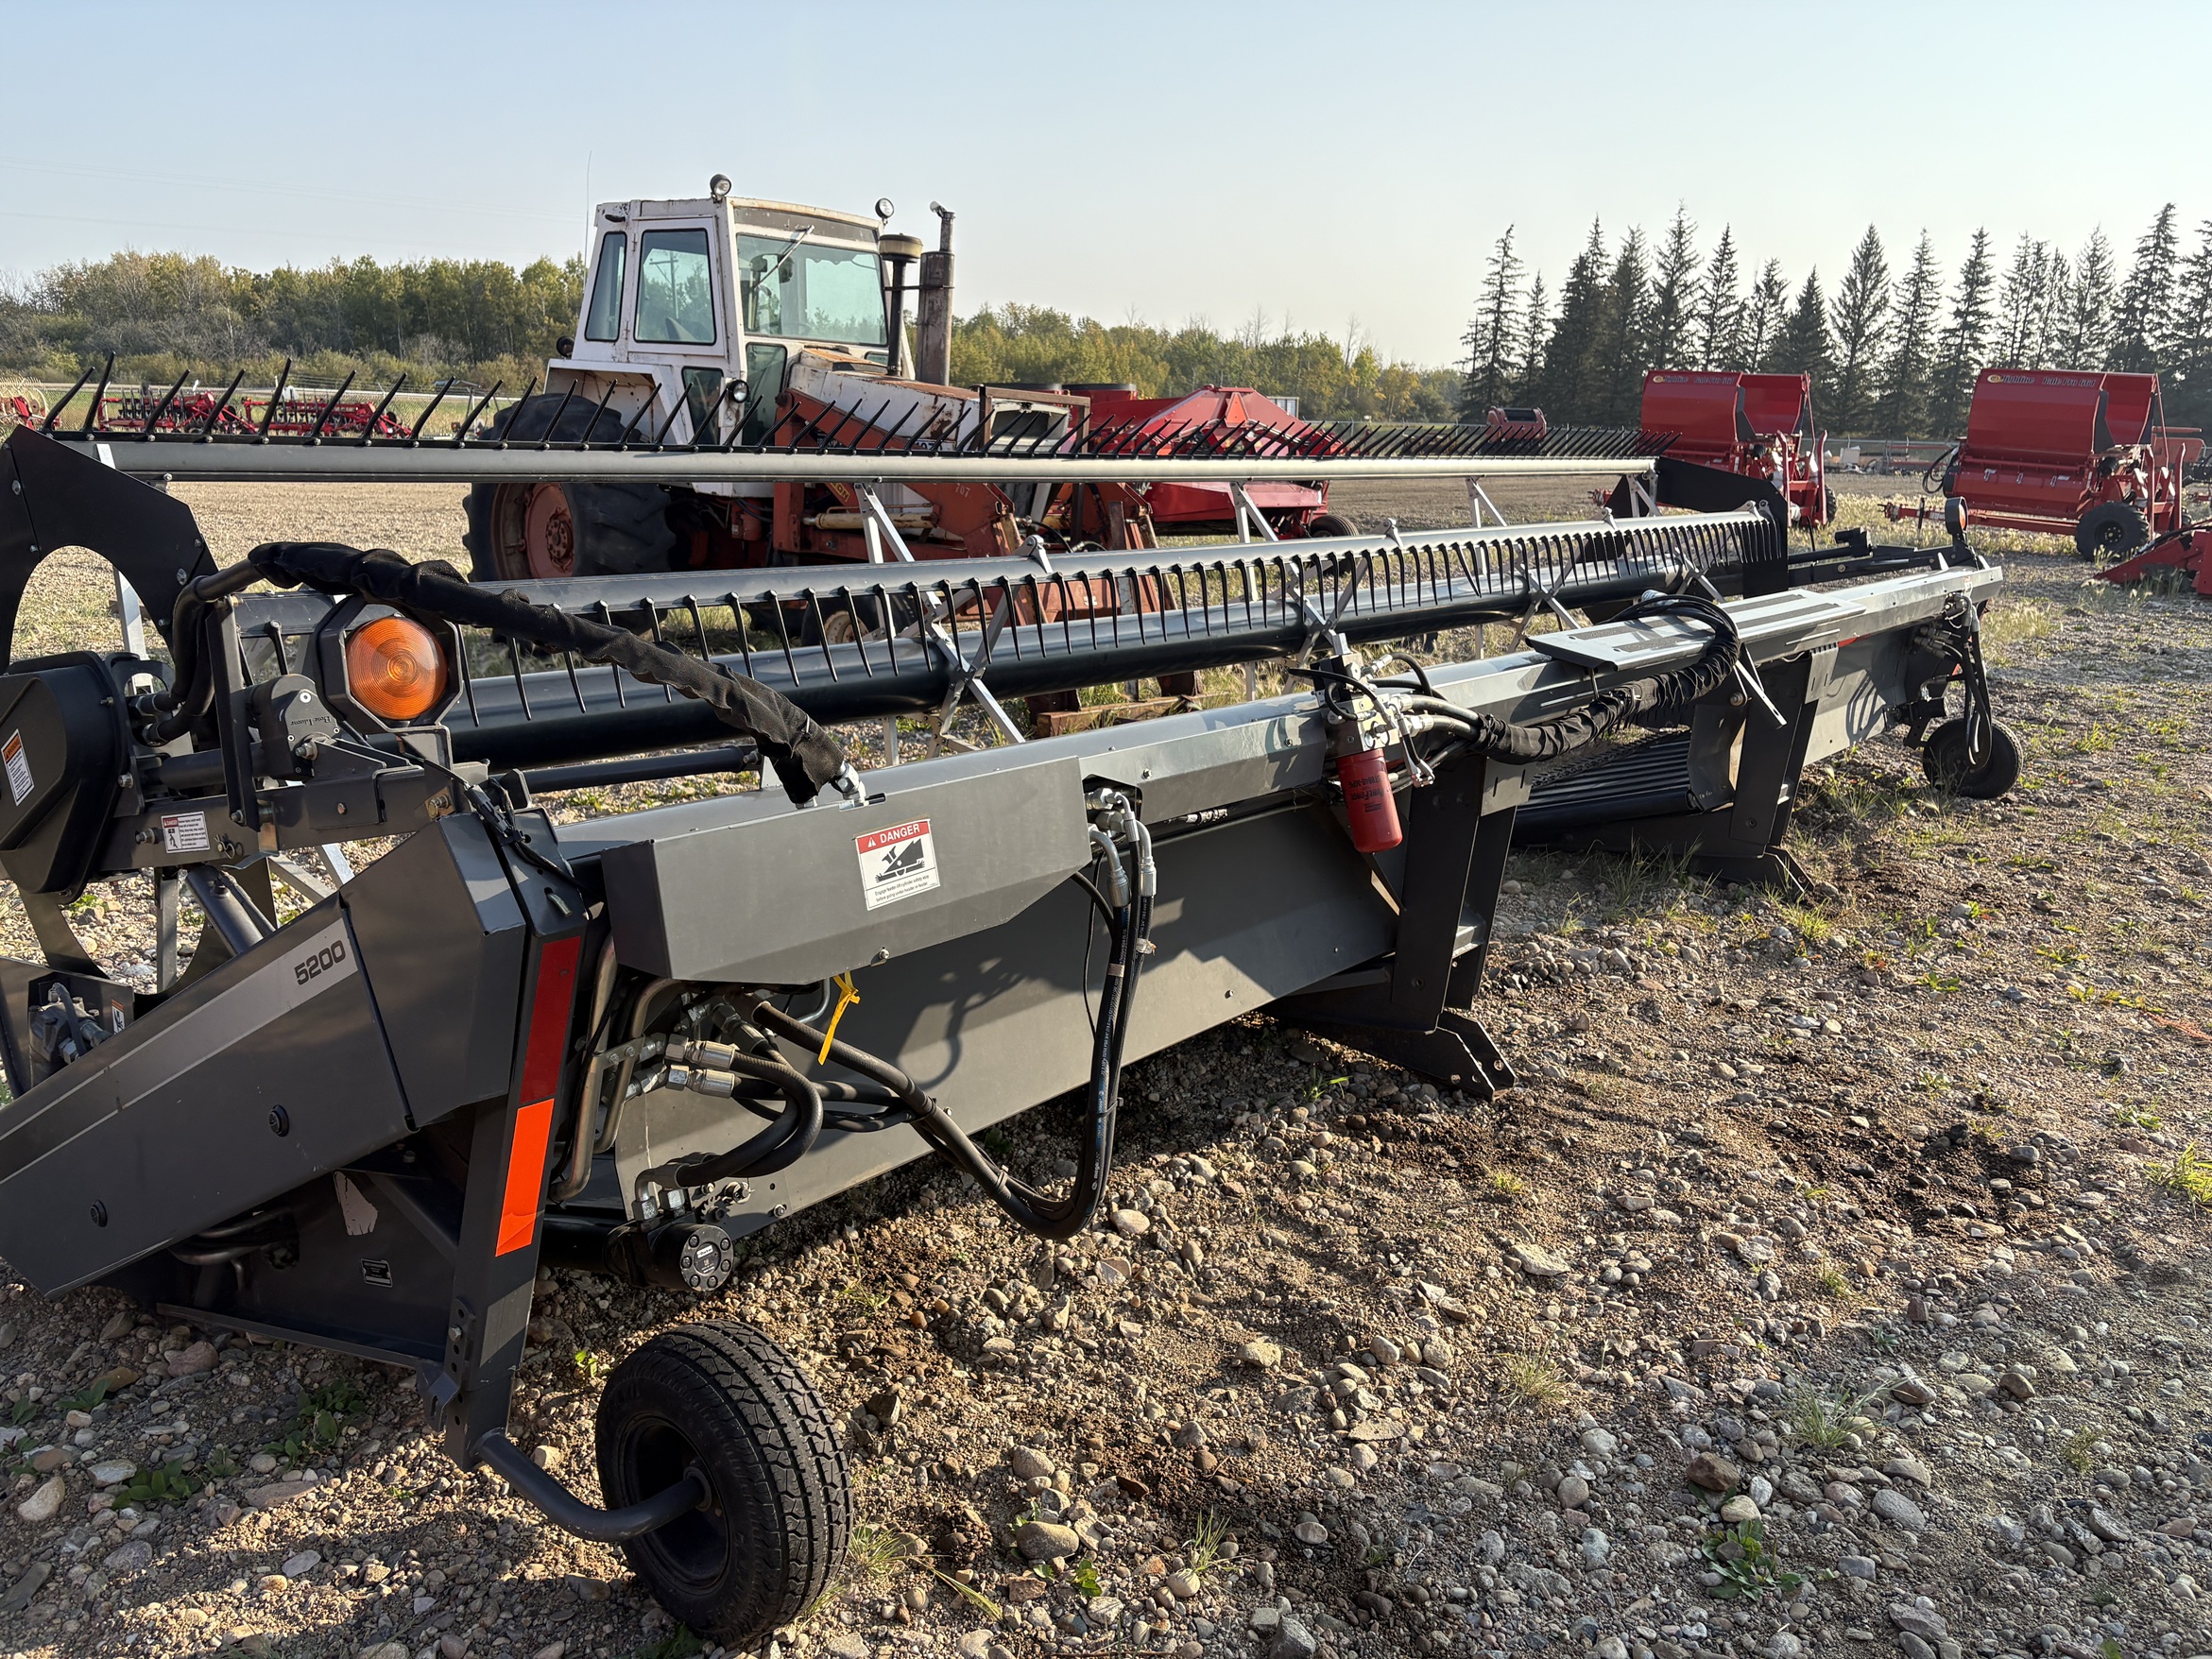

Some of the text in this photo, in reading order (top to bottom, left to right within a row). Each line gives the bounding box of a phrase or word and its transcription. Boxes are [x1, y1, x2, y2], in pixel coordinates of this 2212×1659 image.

[955, 483, 970, 498] 707
[880, 823, 920, 844] DANGER
[294, 939, 346, 985] 5200
